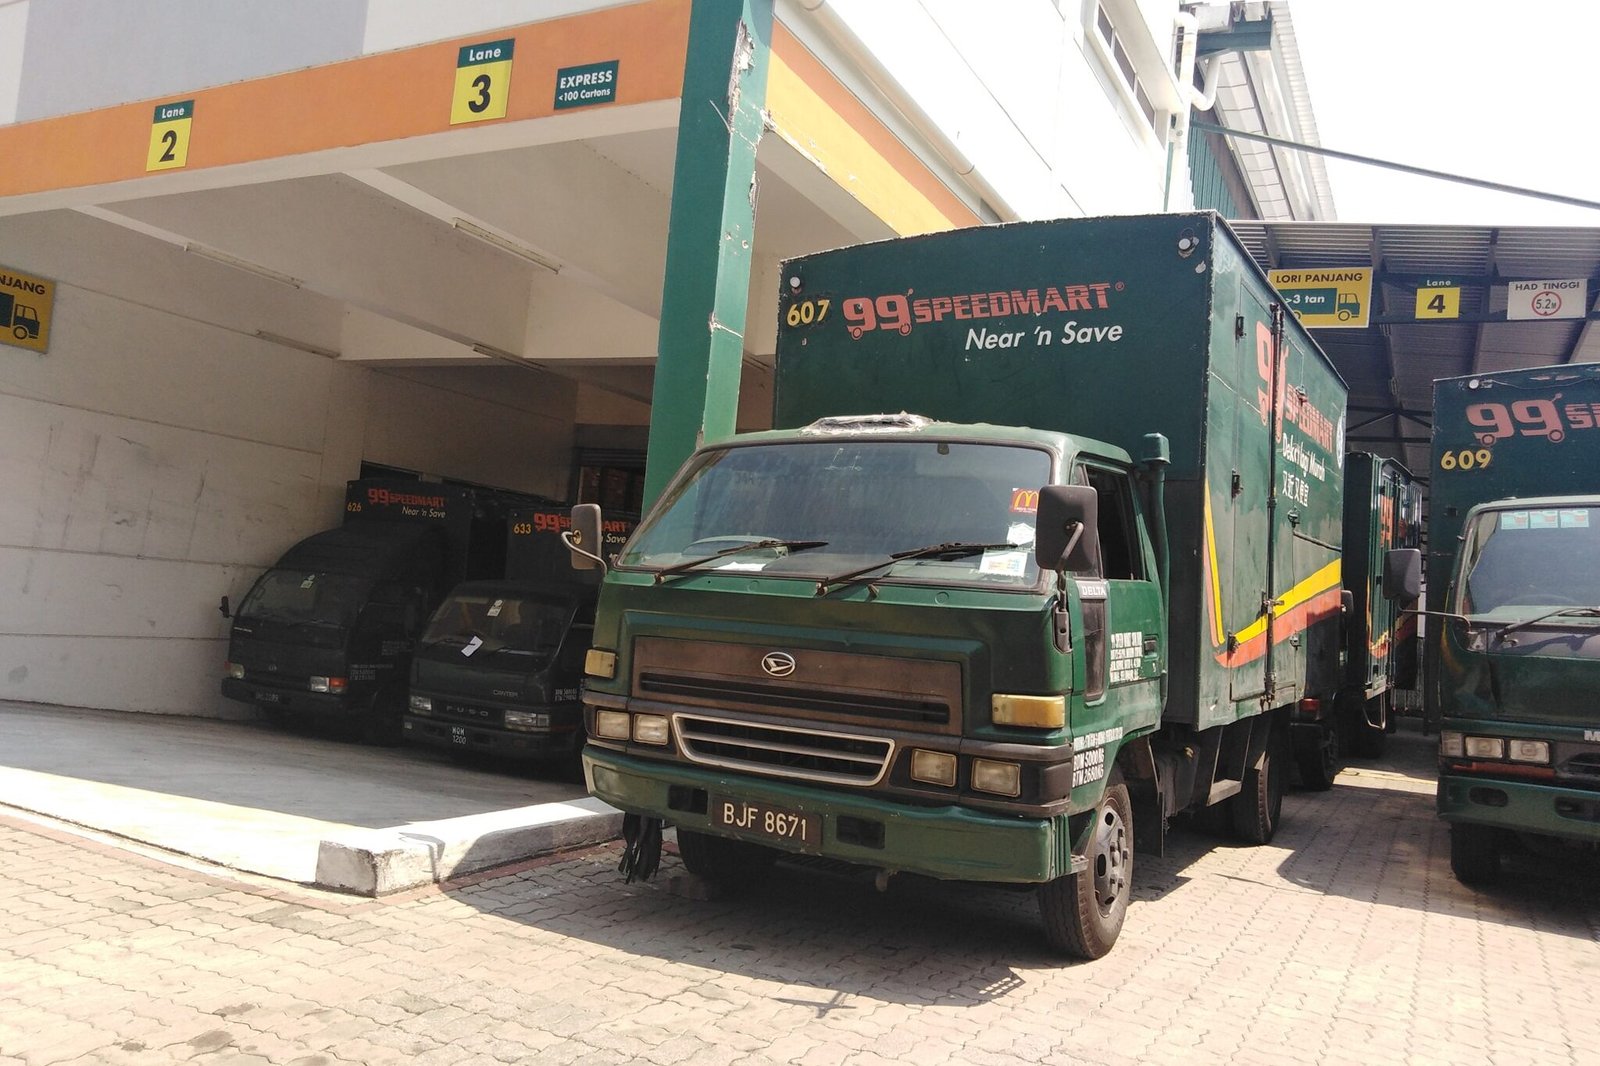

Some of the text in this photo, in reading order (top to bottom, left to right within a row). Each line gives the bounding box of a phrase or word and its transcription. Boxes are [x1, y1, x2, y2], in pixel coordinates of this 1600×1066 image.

[469, 47, 502, 62] Lane
[560, 70, 613, 89] EXPRESS
[468, 74, 492, 113] 3
[558, 88, 611, 102] <100 Cartons
[161, 107, 185, 119] Lane
[159, 130, 177, 163] 2
[1275, 273, 1363, 283] LORI PANJANG
[1426, 279, 1451, 287] Lane
[1542, 281, 1580, 290] TINGGI
[1304, 295, 1325, 304] tan
[1427, 294, 1446, 313] 4
[786, 300, 830, 326] 607
[842, 282, 1112, 340] 99 SPEEDMART
[964, 328, 1025, 351] Near
[1061, 321, 1124, 345] Save
[1440, 449, 1492, 471] 609
[347, 501, 362, 513] 626
[401, 505, 418, 516] Near
[428, 508, 446, 519] Save
[513, 522, 532, 535] 633
[606, 533, 627, 544] Save
[1081, 585, 1107, 597] DELTA
[723, 802, 807, 841] BJF 8671
